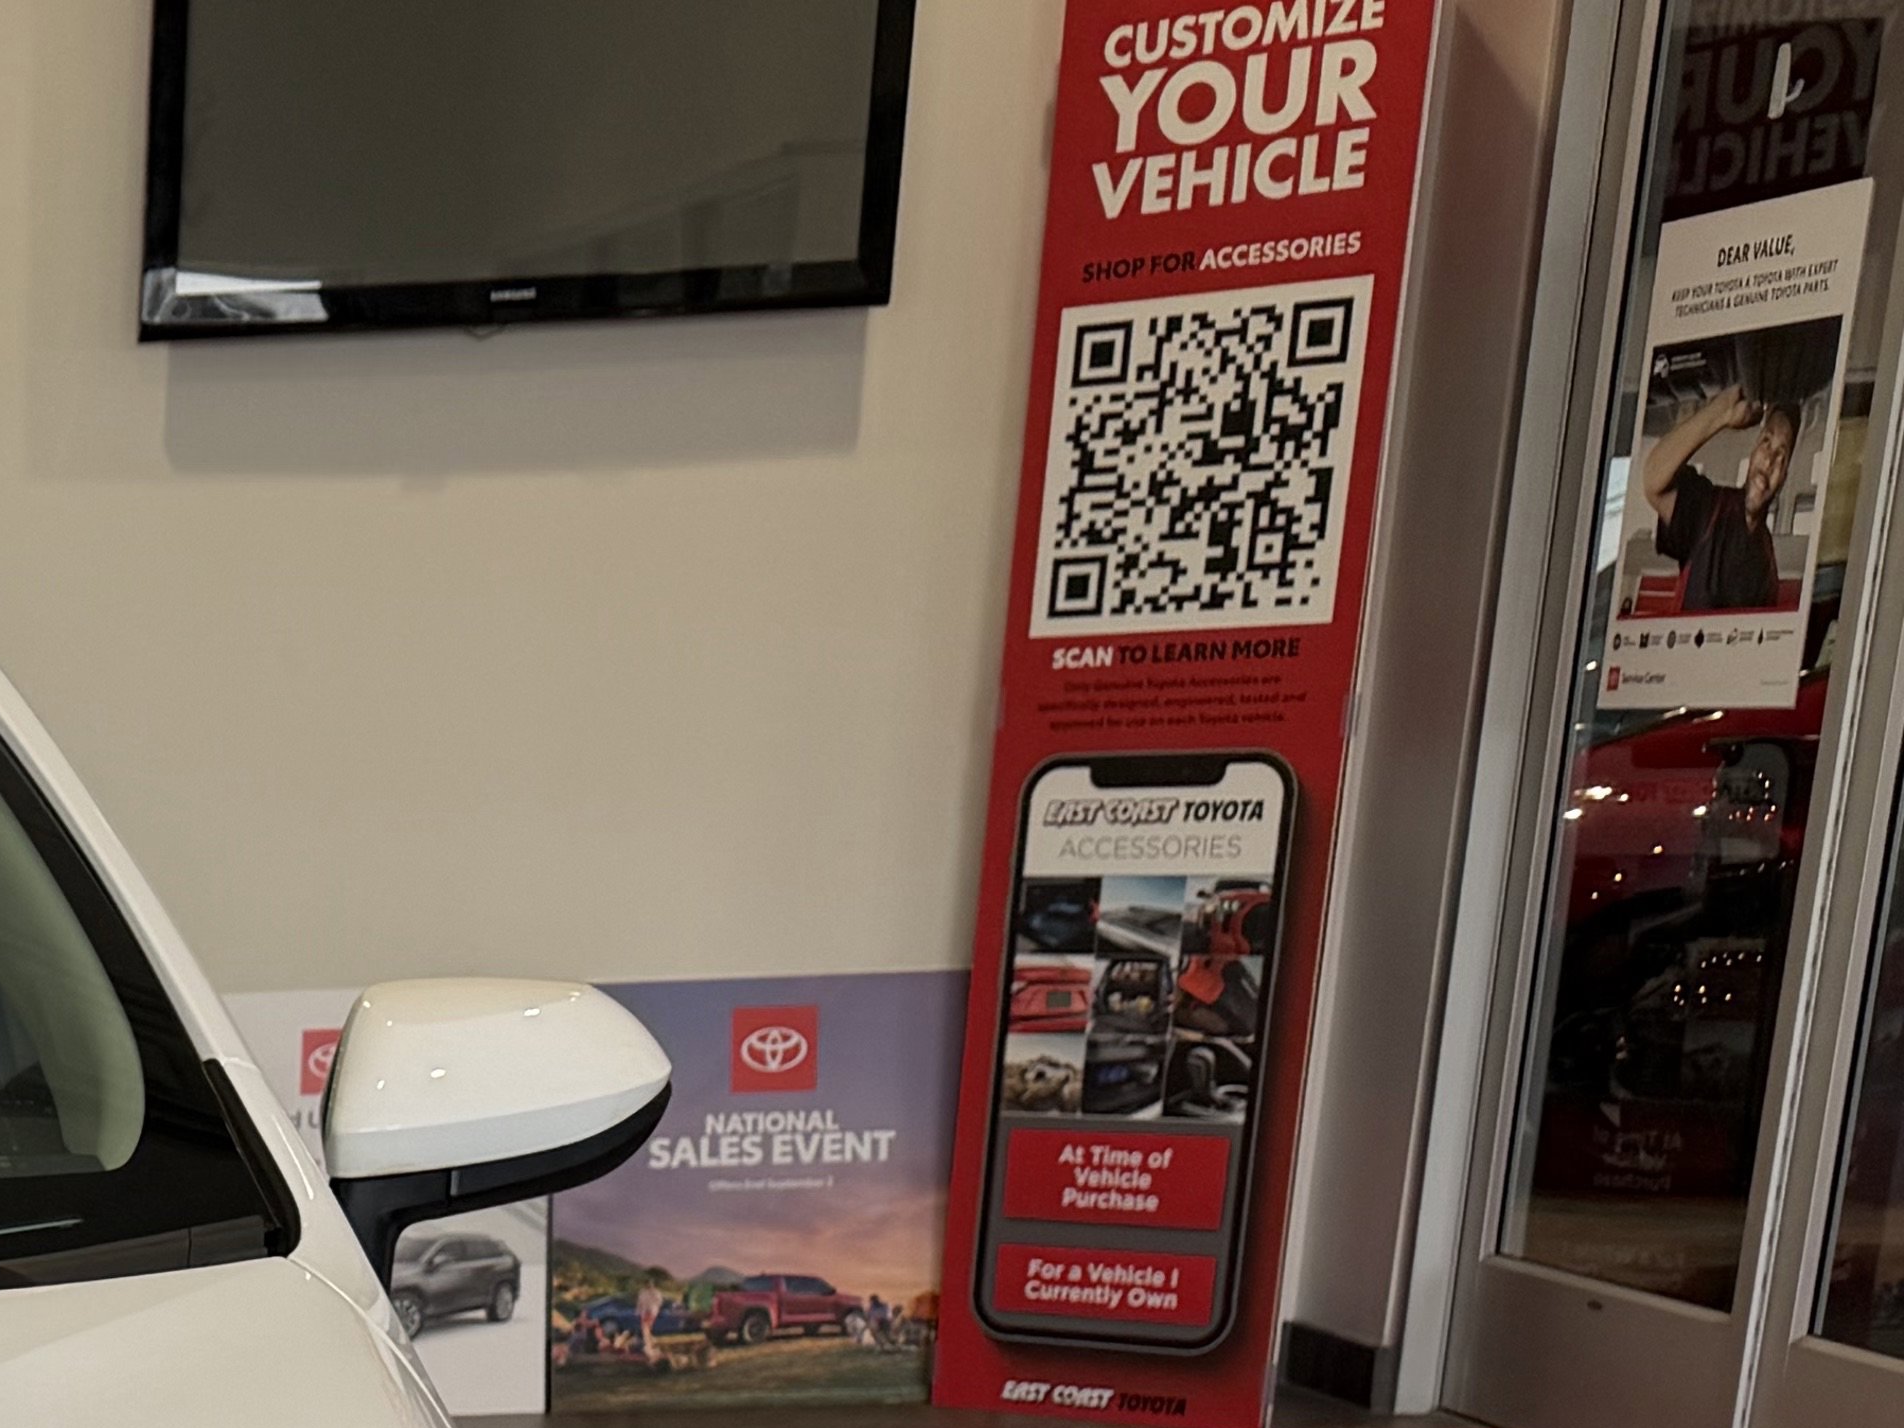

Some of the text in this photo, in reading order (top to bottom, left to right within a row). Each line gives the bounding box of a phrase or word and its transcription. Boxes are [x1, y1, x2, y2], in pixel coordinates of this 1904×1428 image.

[1104, 0, 1385, 68] CUSTOMIZE
[1099, 39, 1377, 153] YOUR
[1092, 127, 1370, 219] VEHICLE
[1083, 231, 1361, 283] SHOP FOR ACCESSORIES
[1717, 234, 1796, 267] DEAR VALUE,
[1692, 283, 1712, 298] YOUR
[1714, 278, 1743, 294] TOYOTA
[1753, 270, 1782, 287] TOYOTA
[1808, 259, 1839, 277] EXPERT
[1733, 291, 1769, 307] GENUINE
[1771, 284, 1800, 300] TOYOTA
[1052, 637, 1301, 670] SCAN TO LEARN MORE
[1183, 798, 1265, 823] TOYOTA
[1058, 835, 1242, 860] ACCESSORIES
[705, 1109, 840, 1134] NATIONAL
[648, 1130, 896, 1169] SALES EVENT
[1058, 1144, 1173, 1169] At Time of
[1074, 1166, 1152, 1190] Vehicle
[1061, 1187, 1159, 1212] Purchase
[1027, 1258, 1065, 1279] For
[1068, 1264, 1082, 1282] a
[1088, 1262, 1165, 1288] Vehicle
[1024, 1280, 1178, 1310] Currently Own
[1118, 1392, 1187, 1416] TOYOTA
